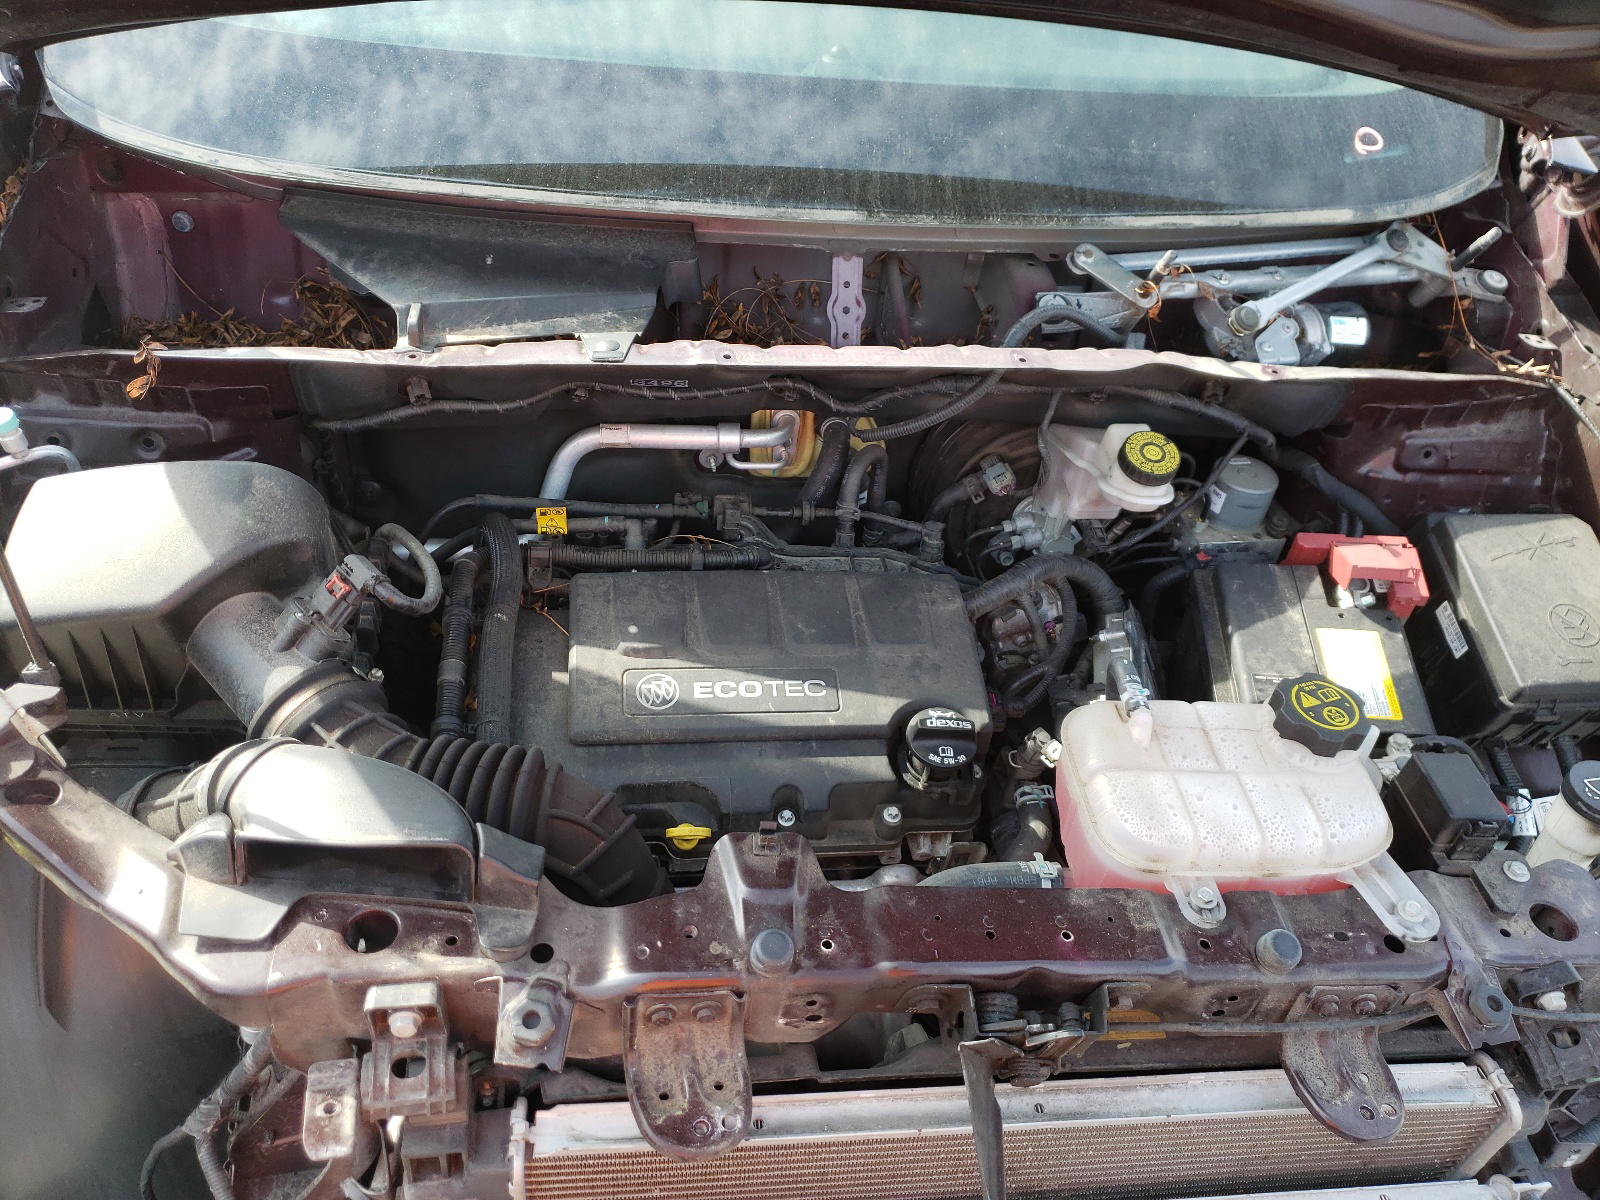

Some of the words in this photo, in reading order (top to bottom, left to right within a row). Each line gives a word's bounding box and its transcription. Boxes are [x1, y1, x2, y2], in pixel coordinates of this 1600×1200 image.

[693, 679, 827, 699] ECOTEC
[926, 717, 972, 729] dexos
[928, 753, 942, 764] SAE
[943, 754, 967, 765] 5W-30
